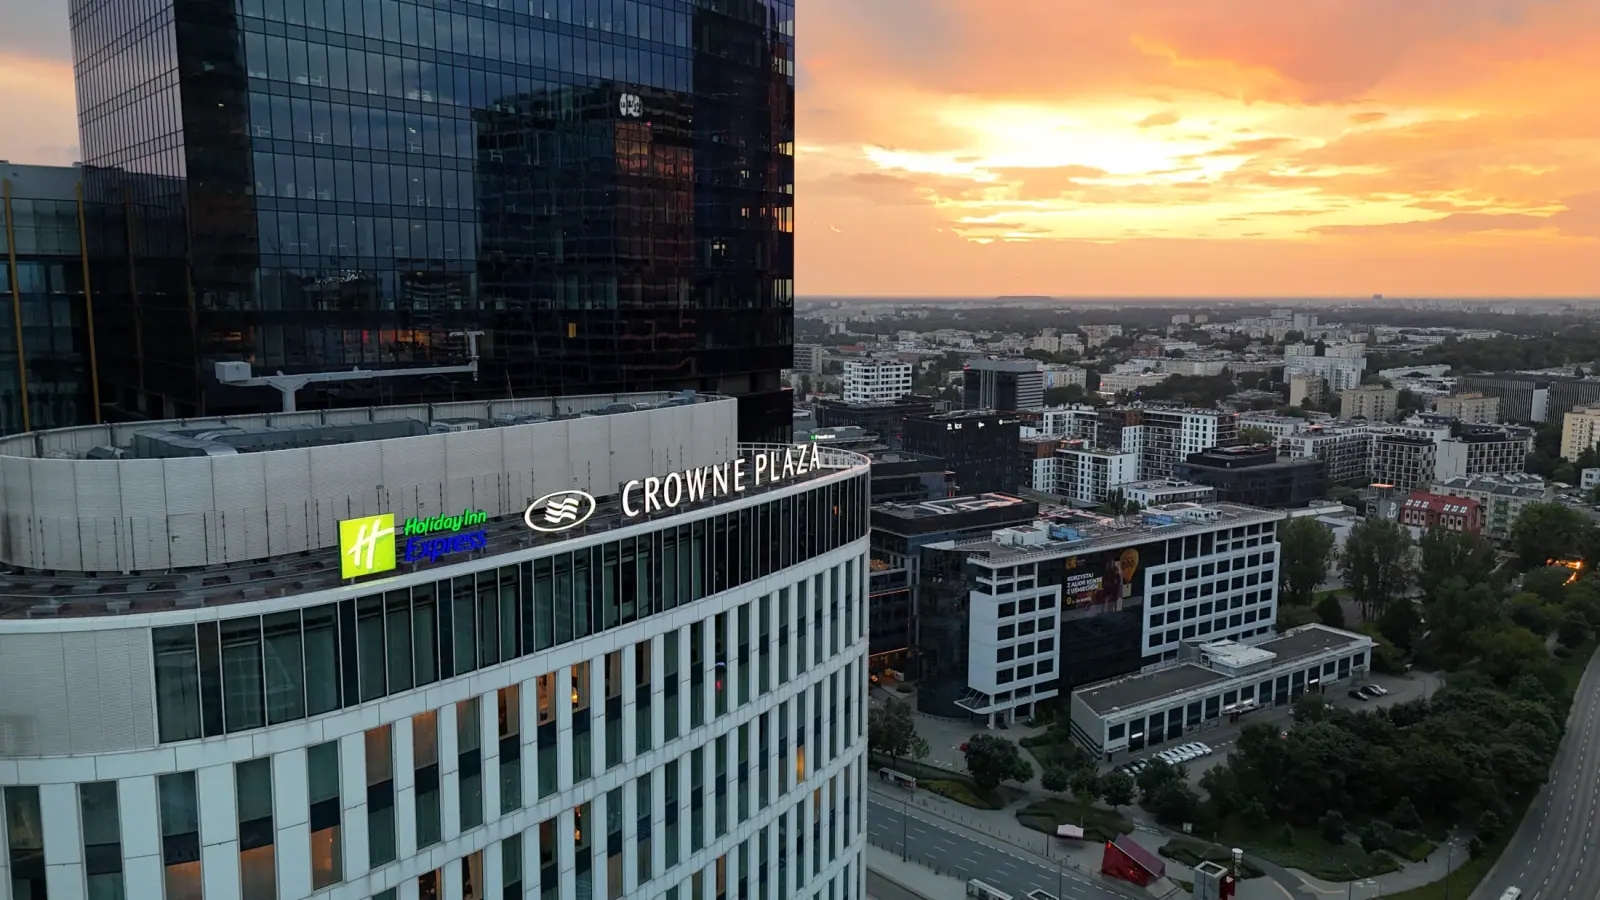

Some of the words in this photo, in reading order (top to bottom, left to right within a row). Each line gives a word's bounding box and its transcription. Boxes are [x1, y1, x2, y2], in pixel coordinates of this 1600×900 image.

[622, 458, 746, 517] CROWNE
[755, 441, 821, 486] PLAZA
[403, 511, 463, 536] Holiday
[463, 508, 488, 526] Inn
[404, 529, 488, 563] Express
[1067, 573, 1094, 582] KORZYSTAJ
